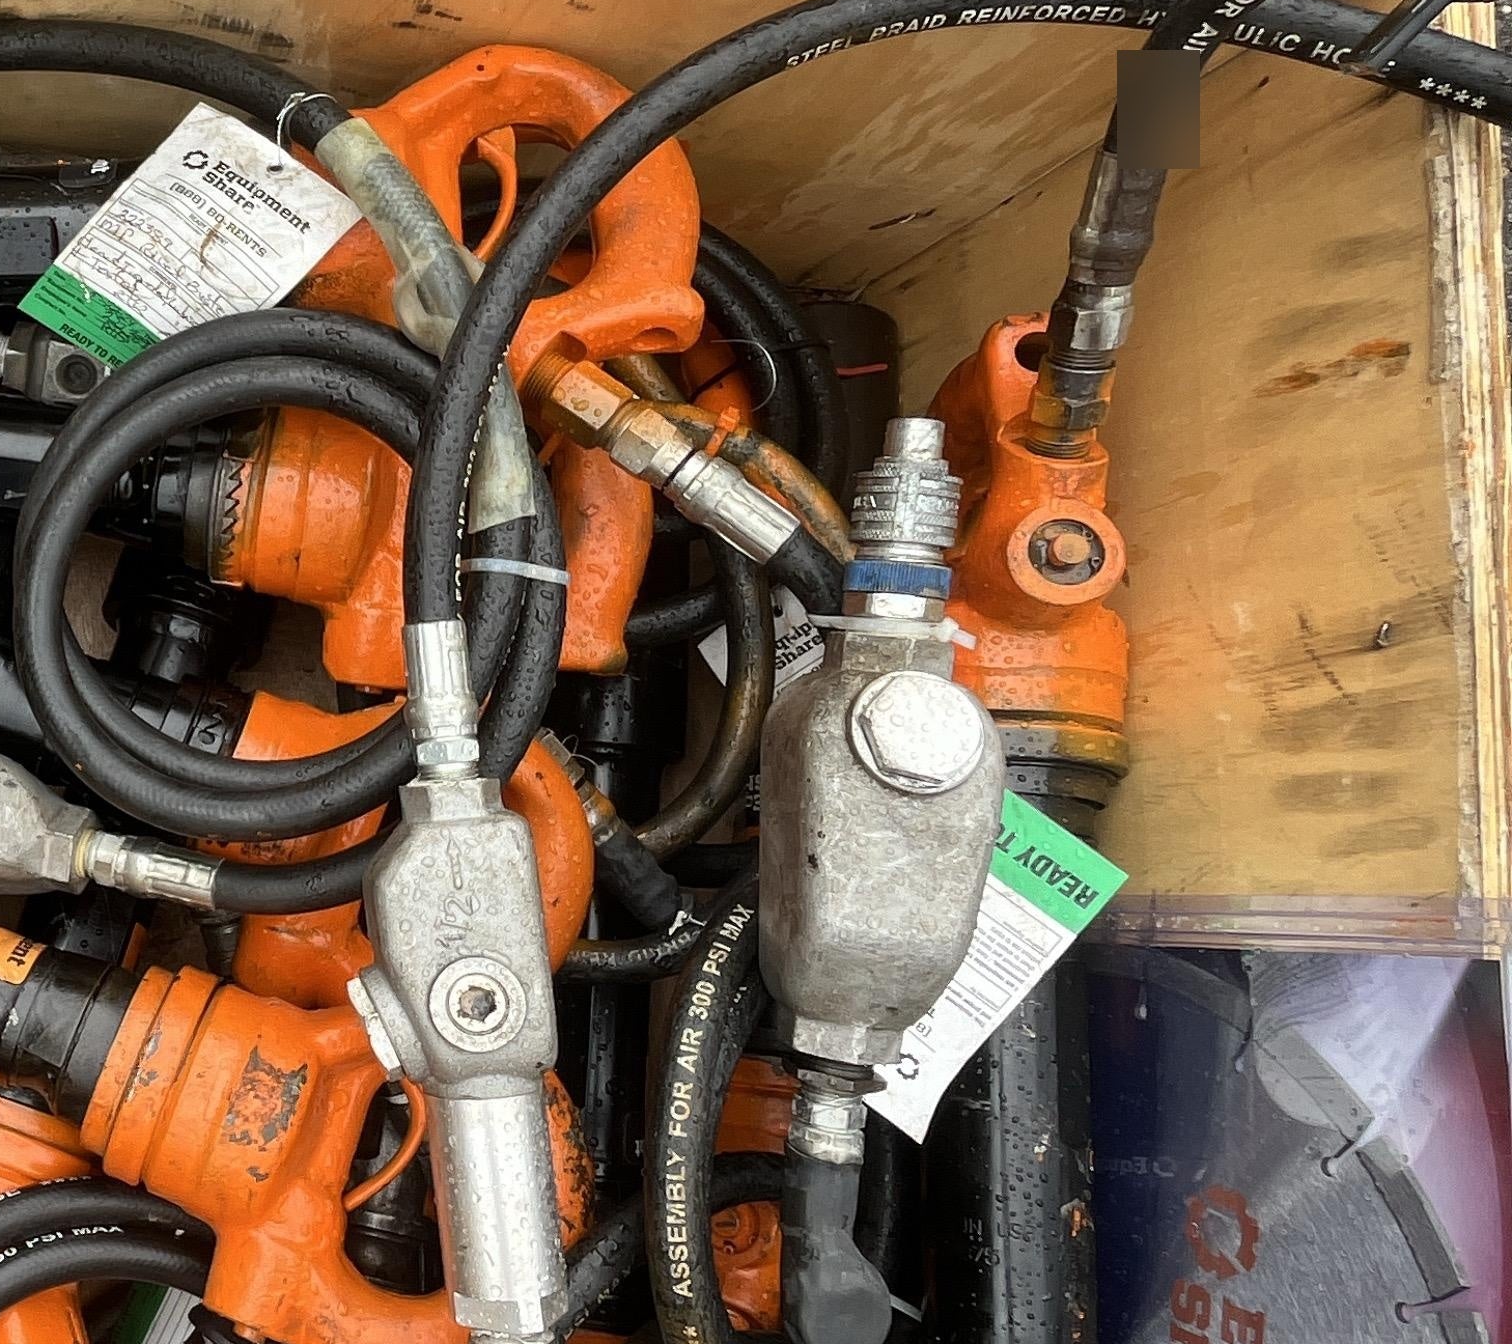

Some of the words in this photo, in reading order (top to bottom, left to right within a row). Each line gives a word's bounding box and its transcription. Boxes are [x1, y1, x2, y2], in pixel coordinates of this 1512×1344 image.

[957, 4, 1126, 26] REINFORCED
[202, 170, 259, 216] Share
[212, 159, 313, 235] Equipment
[59, 321, 93, 351] READY
[92, 345, 109, 361] TO
[108, 355, 124, 370] RE
[1013, 844, 1100, 910] READY
[719, 904, 755, 942] MAX
[701, 940, 732, 977] PSI
[688, 980, 716, 1021] 300
[676, 1025, 704, 1074] AIR
[668, 1080, 694, 1139] FOR
[667, 1151, 694, 1300] ASSEMBLY
